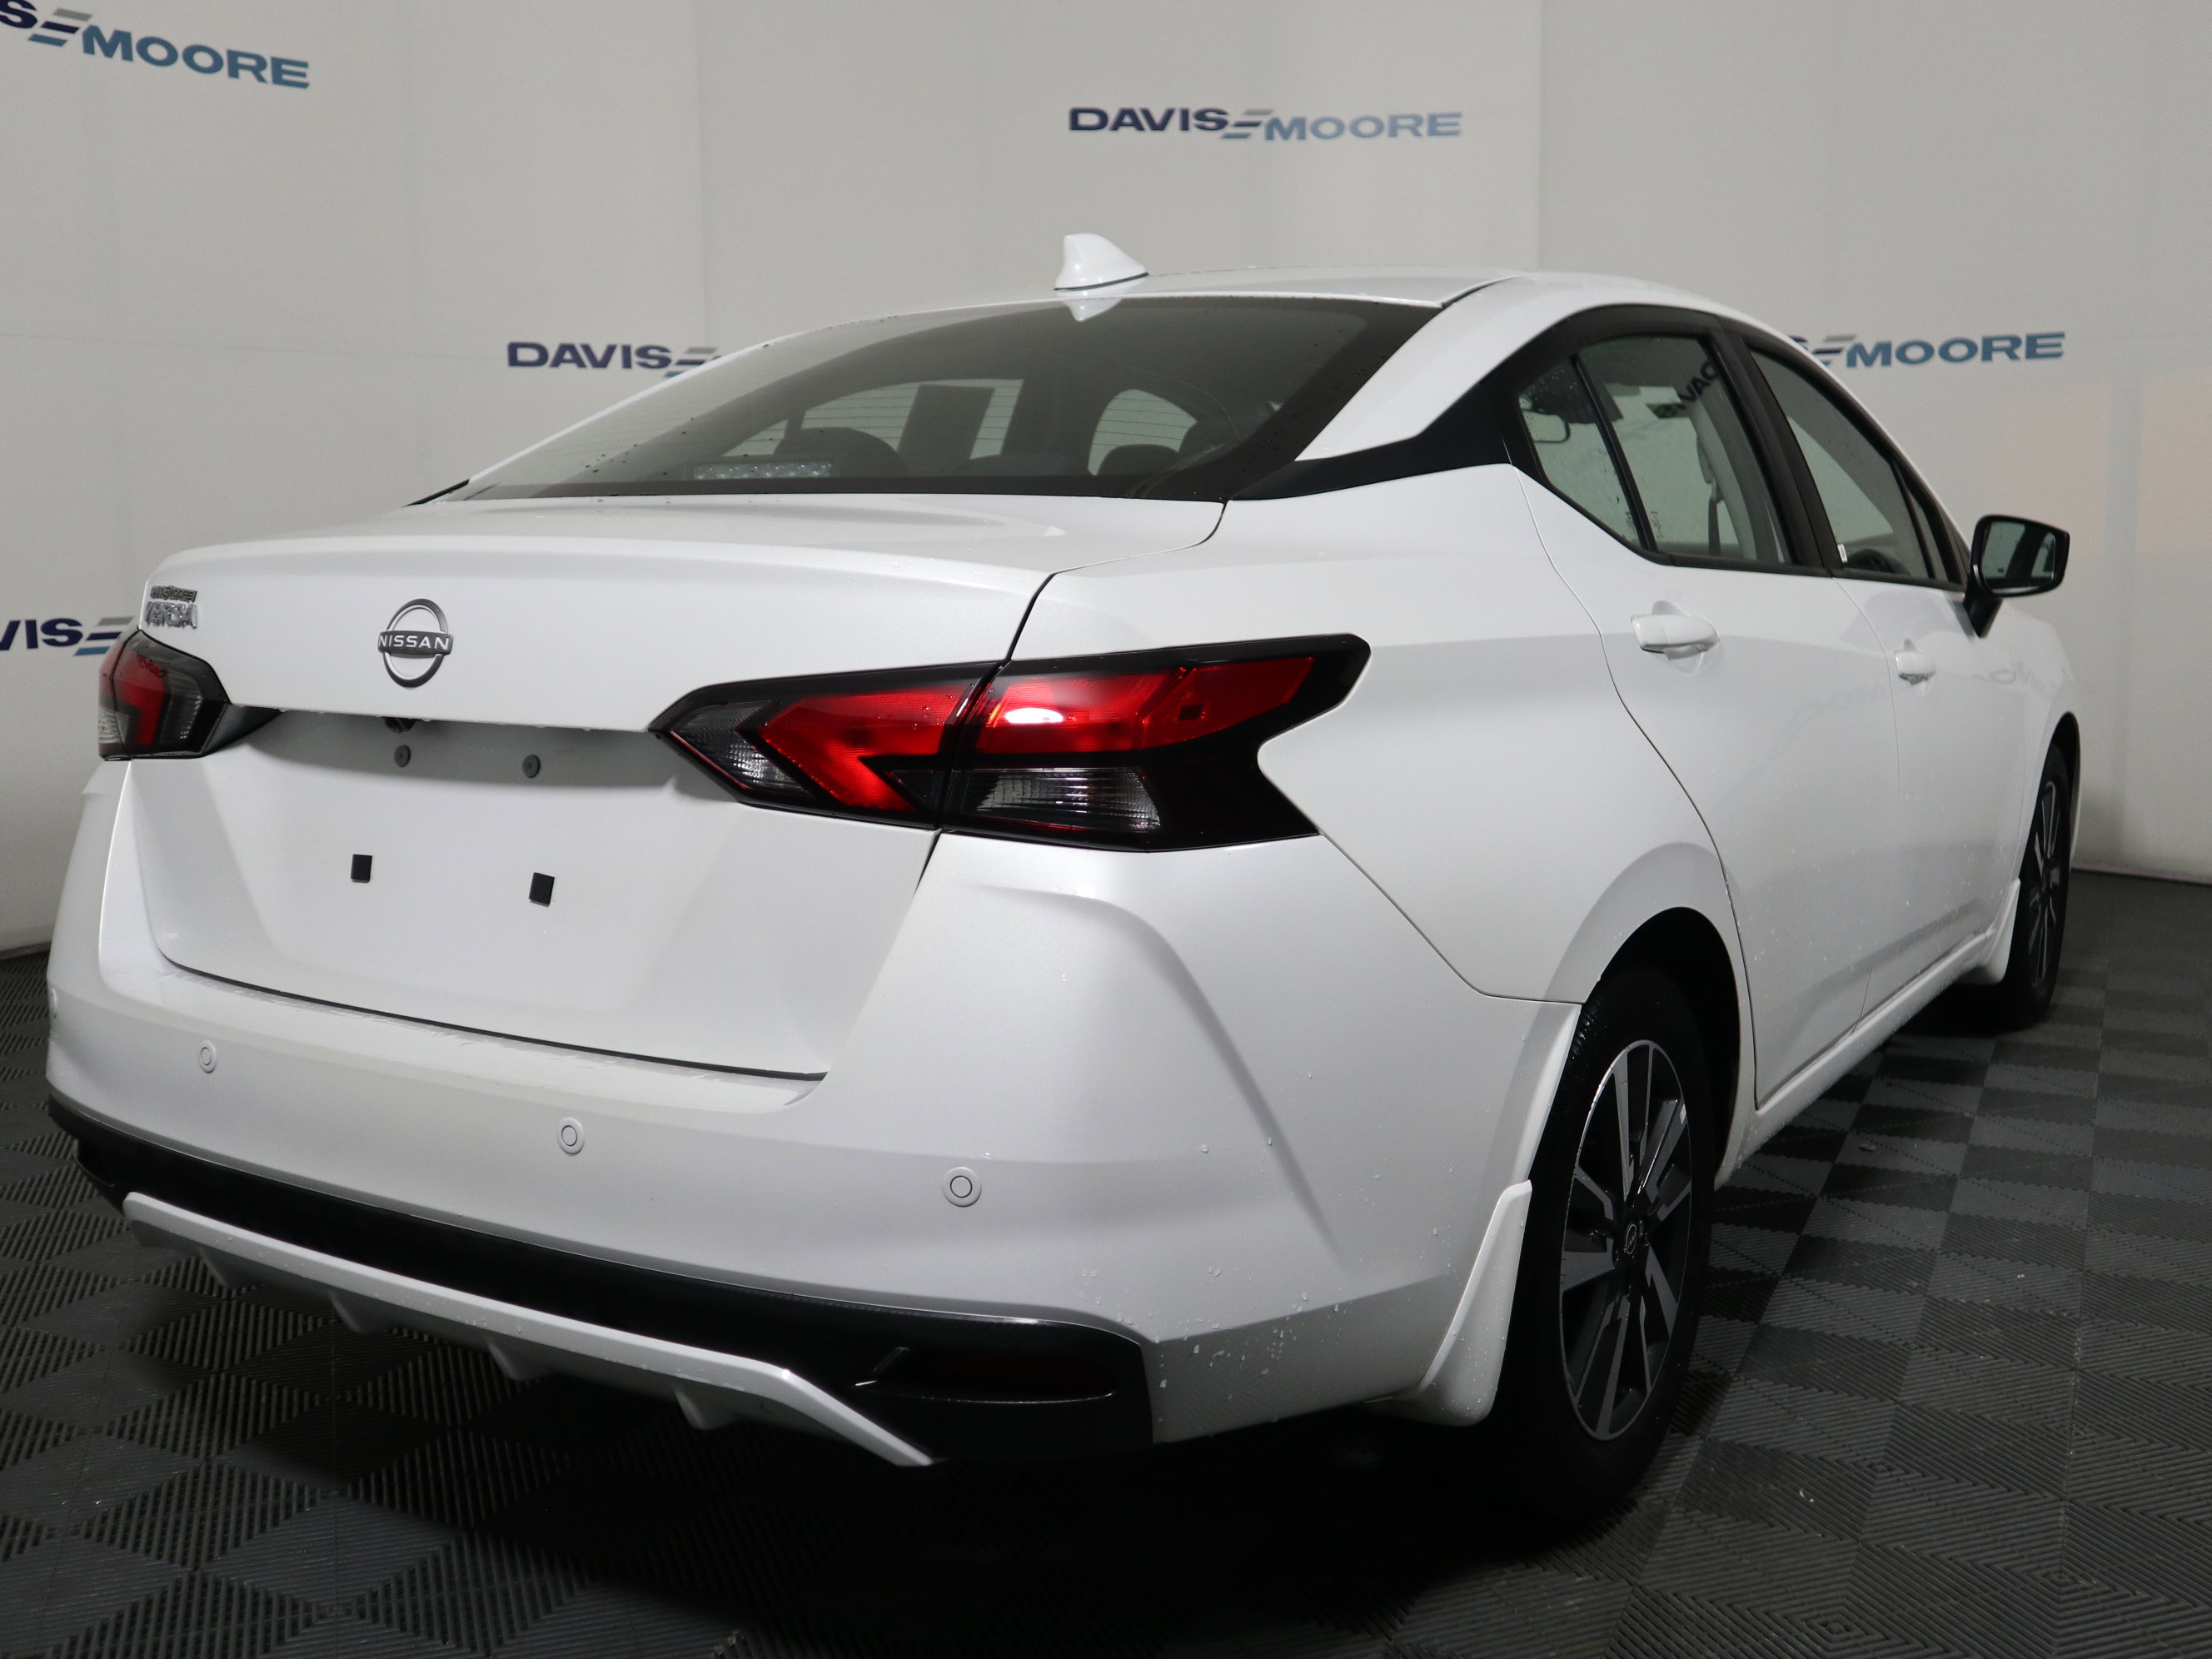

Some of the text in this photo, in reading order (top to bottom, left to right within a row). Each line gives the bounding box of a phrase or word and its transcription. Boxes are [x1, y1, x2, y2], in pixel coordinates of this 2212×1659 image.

[82, 25, 310, 89] MOORE
[1069, 107, 1462, 141] DAVIS MOORE
[507, 341, 671, 369] DAVIS
[1846, 331, 2065, 368] MOORE
[378, 635, 450, 650] NISSAN
